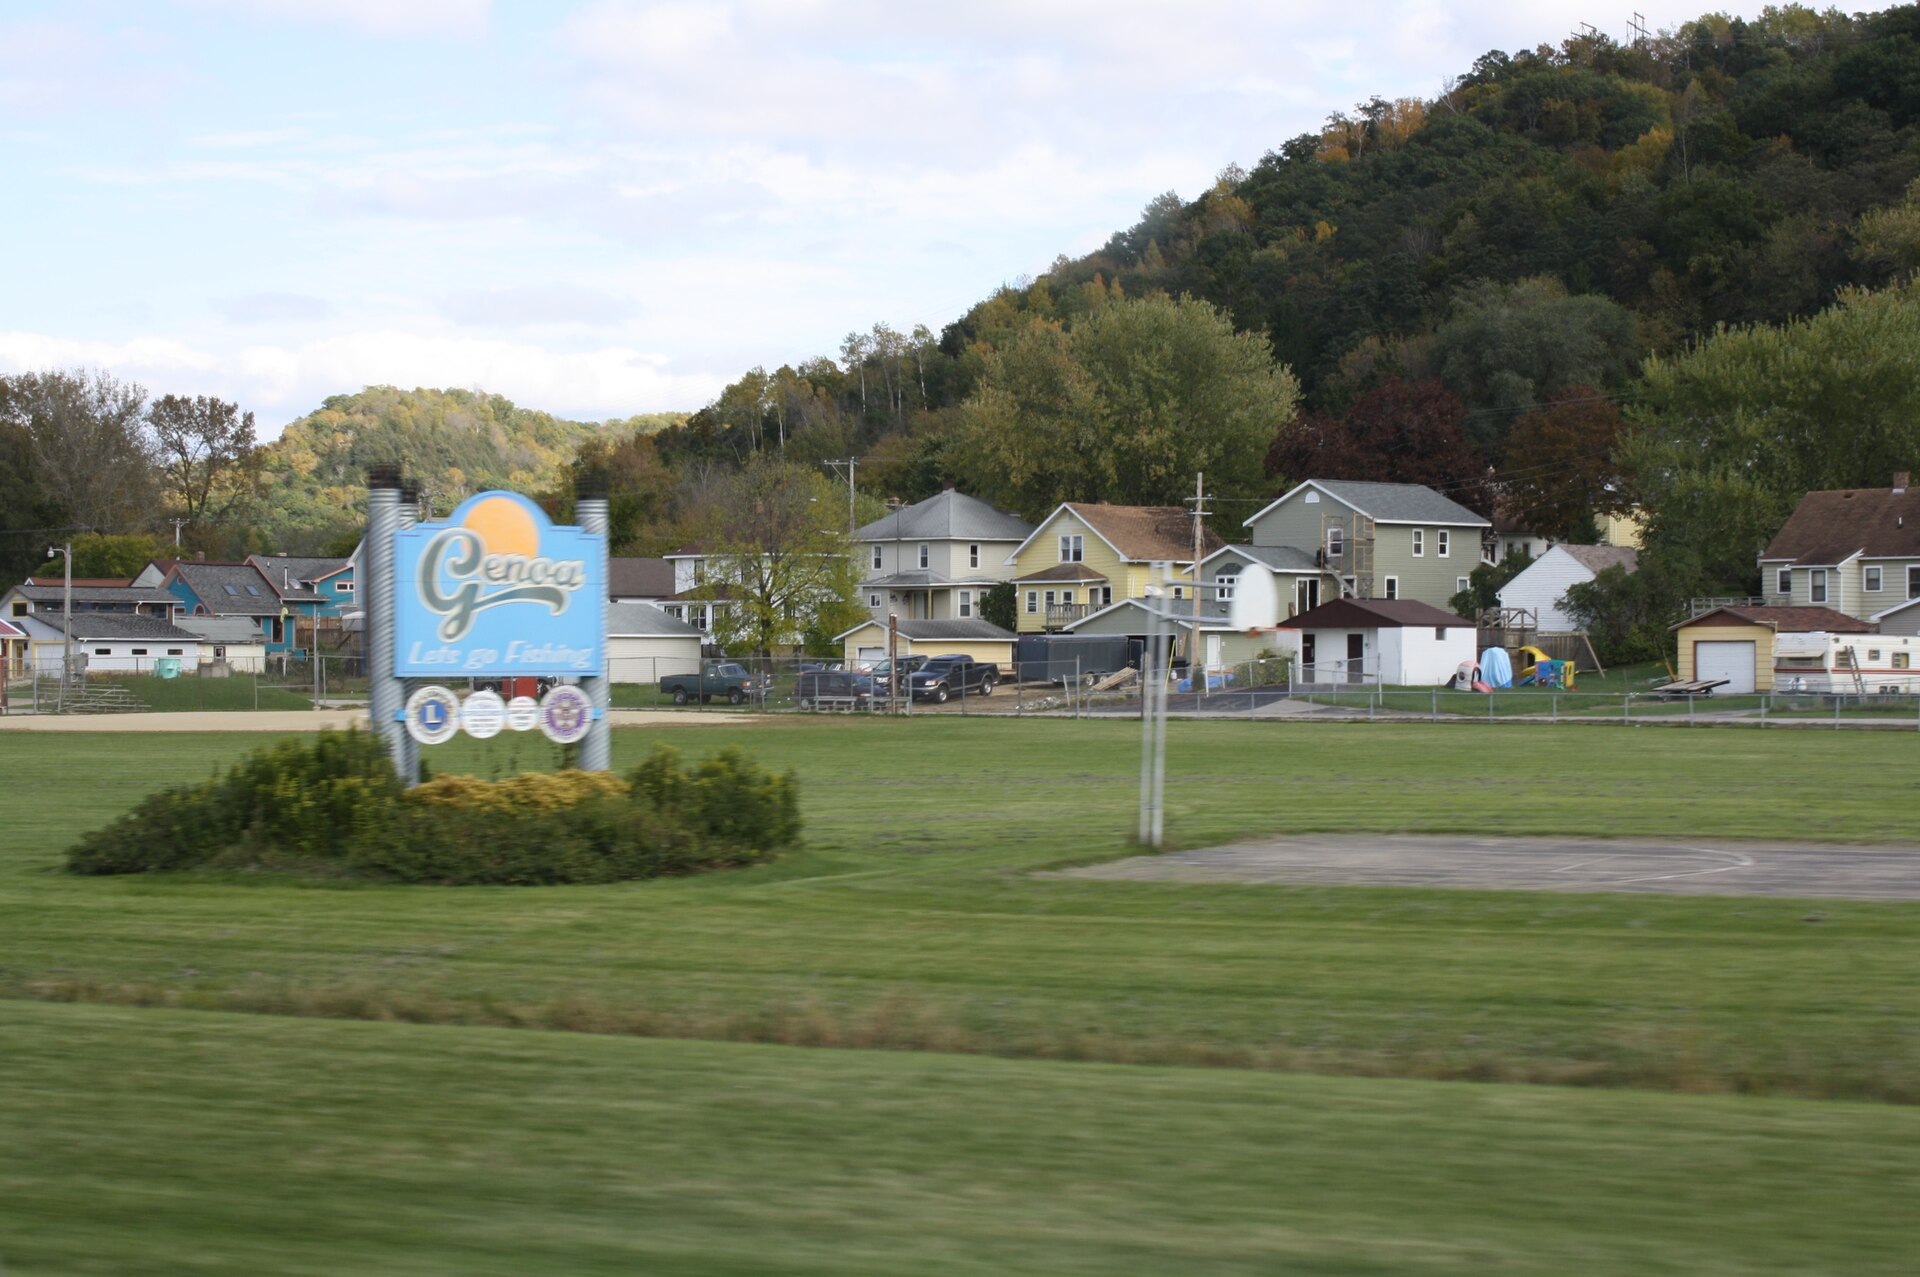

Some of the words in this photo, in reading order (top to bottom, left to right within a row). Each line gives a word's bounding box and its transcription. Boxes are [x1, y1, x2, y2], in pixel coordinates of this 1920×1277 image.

[417, 527, 586, 643] Genoa
[463, 648, 499, 669] go
[504, 640, 594, 669] Fishing
[425, 705, 442, 724] L
